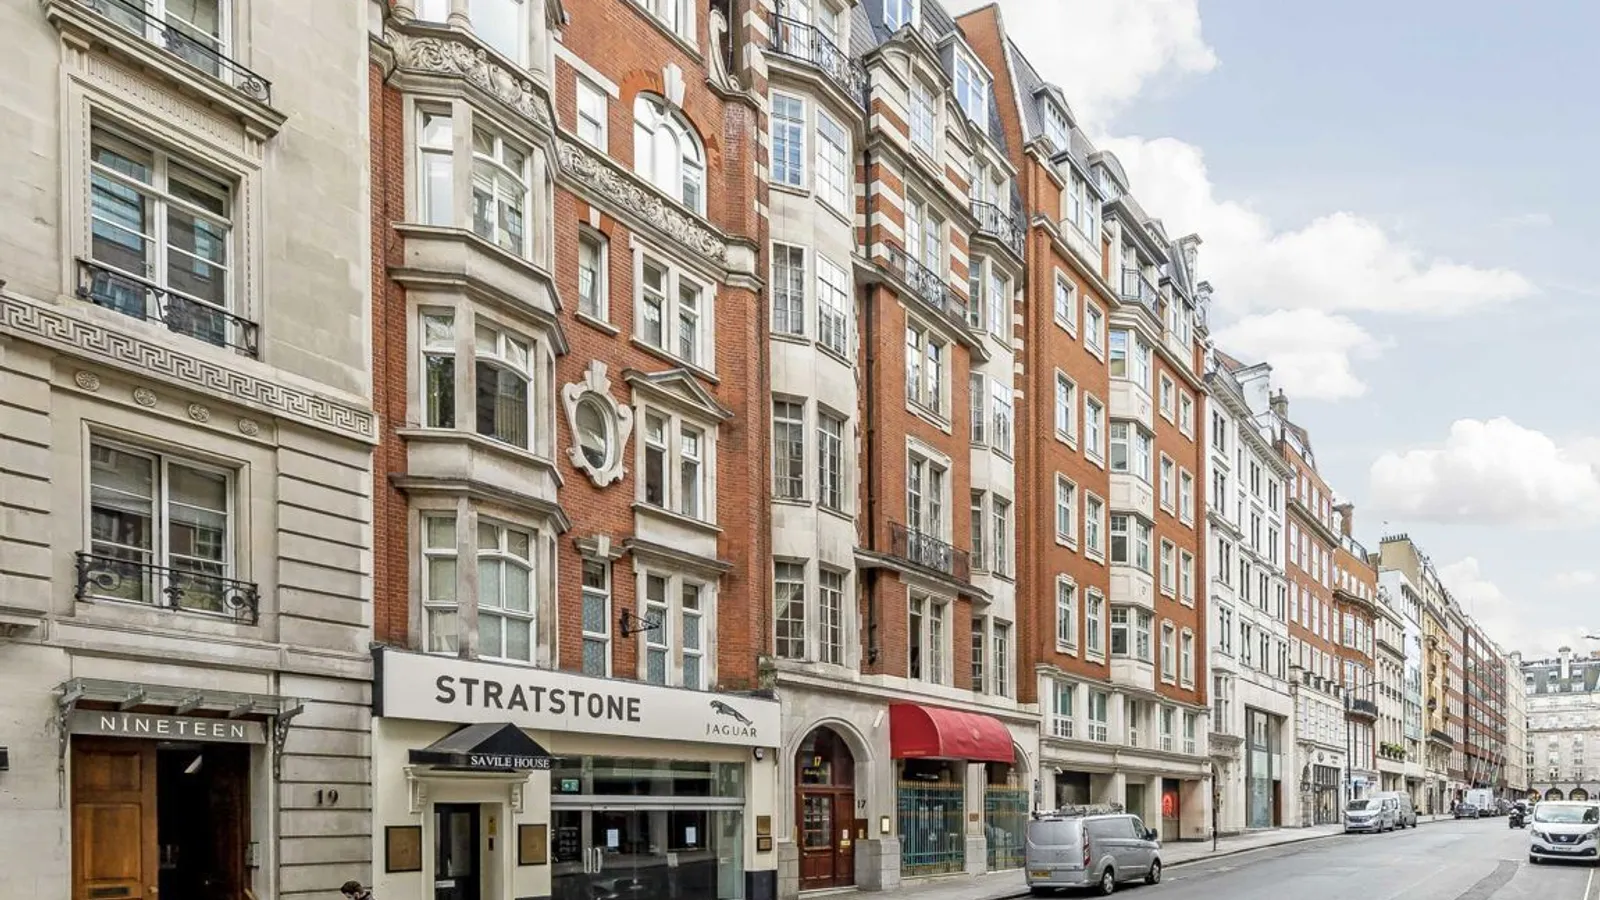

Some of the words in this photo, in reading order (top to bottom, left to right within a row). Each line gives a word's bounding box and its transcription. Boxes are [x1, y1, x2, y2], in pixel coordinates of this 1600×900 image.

[435, 675, 641, 722] STRATSTONE
[100, 716, 244, 738] NINETEEN
[706, 723, 757, 738] JAGUAR
[471, 755, 512, 767] SAVILE
[514, 757, 550, 769] HOUSE
[314, 789, 339, 806] 19
[857, 800, 866, 809] 17
